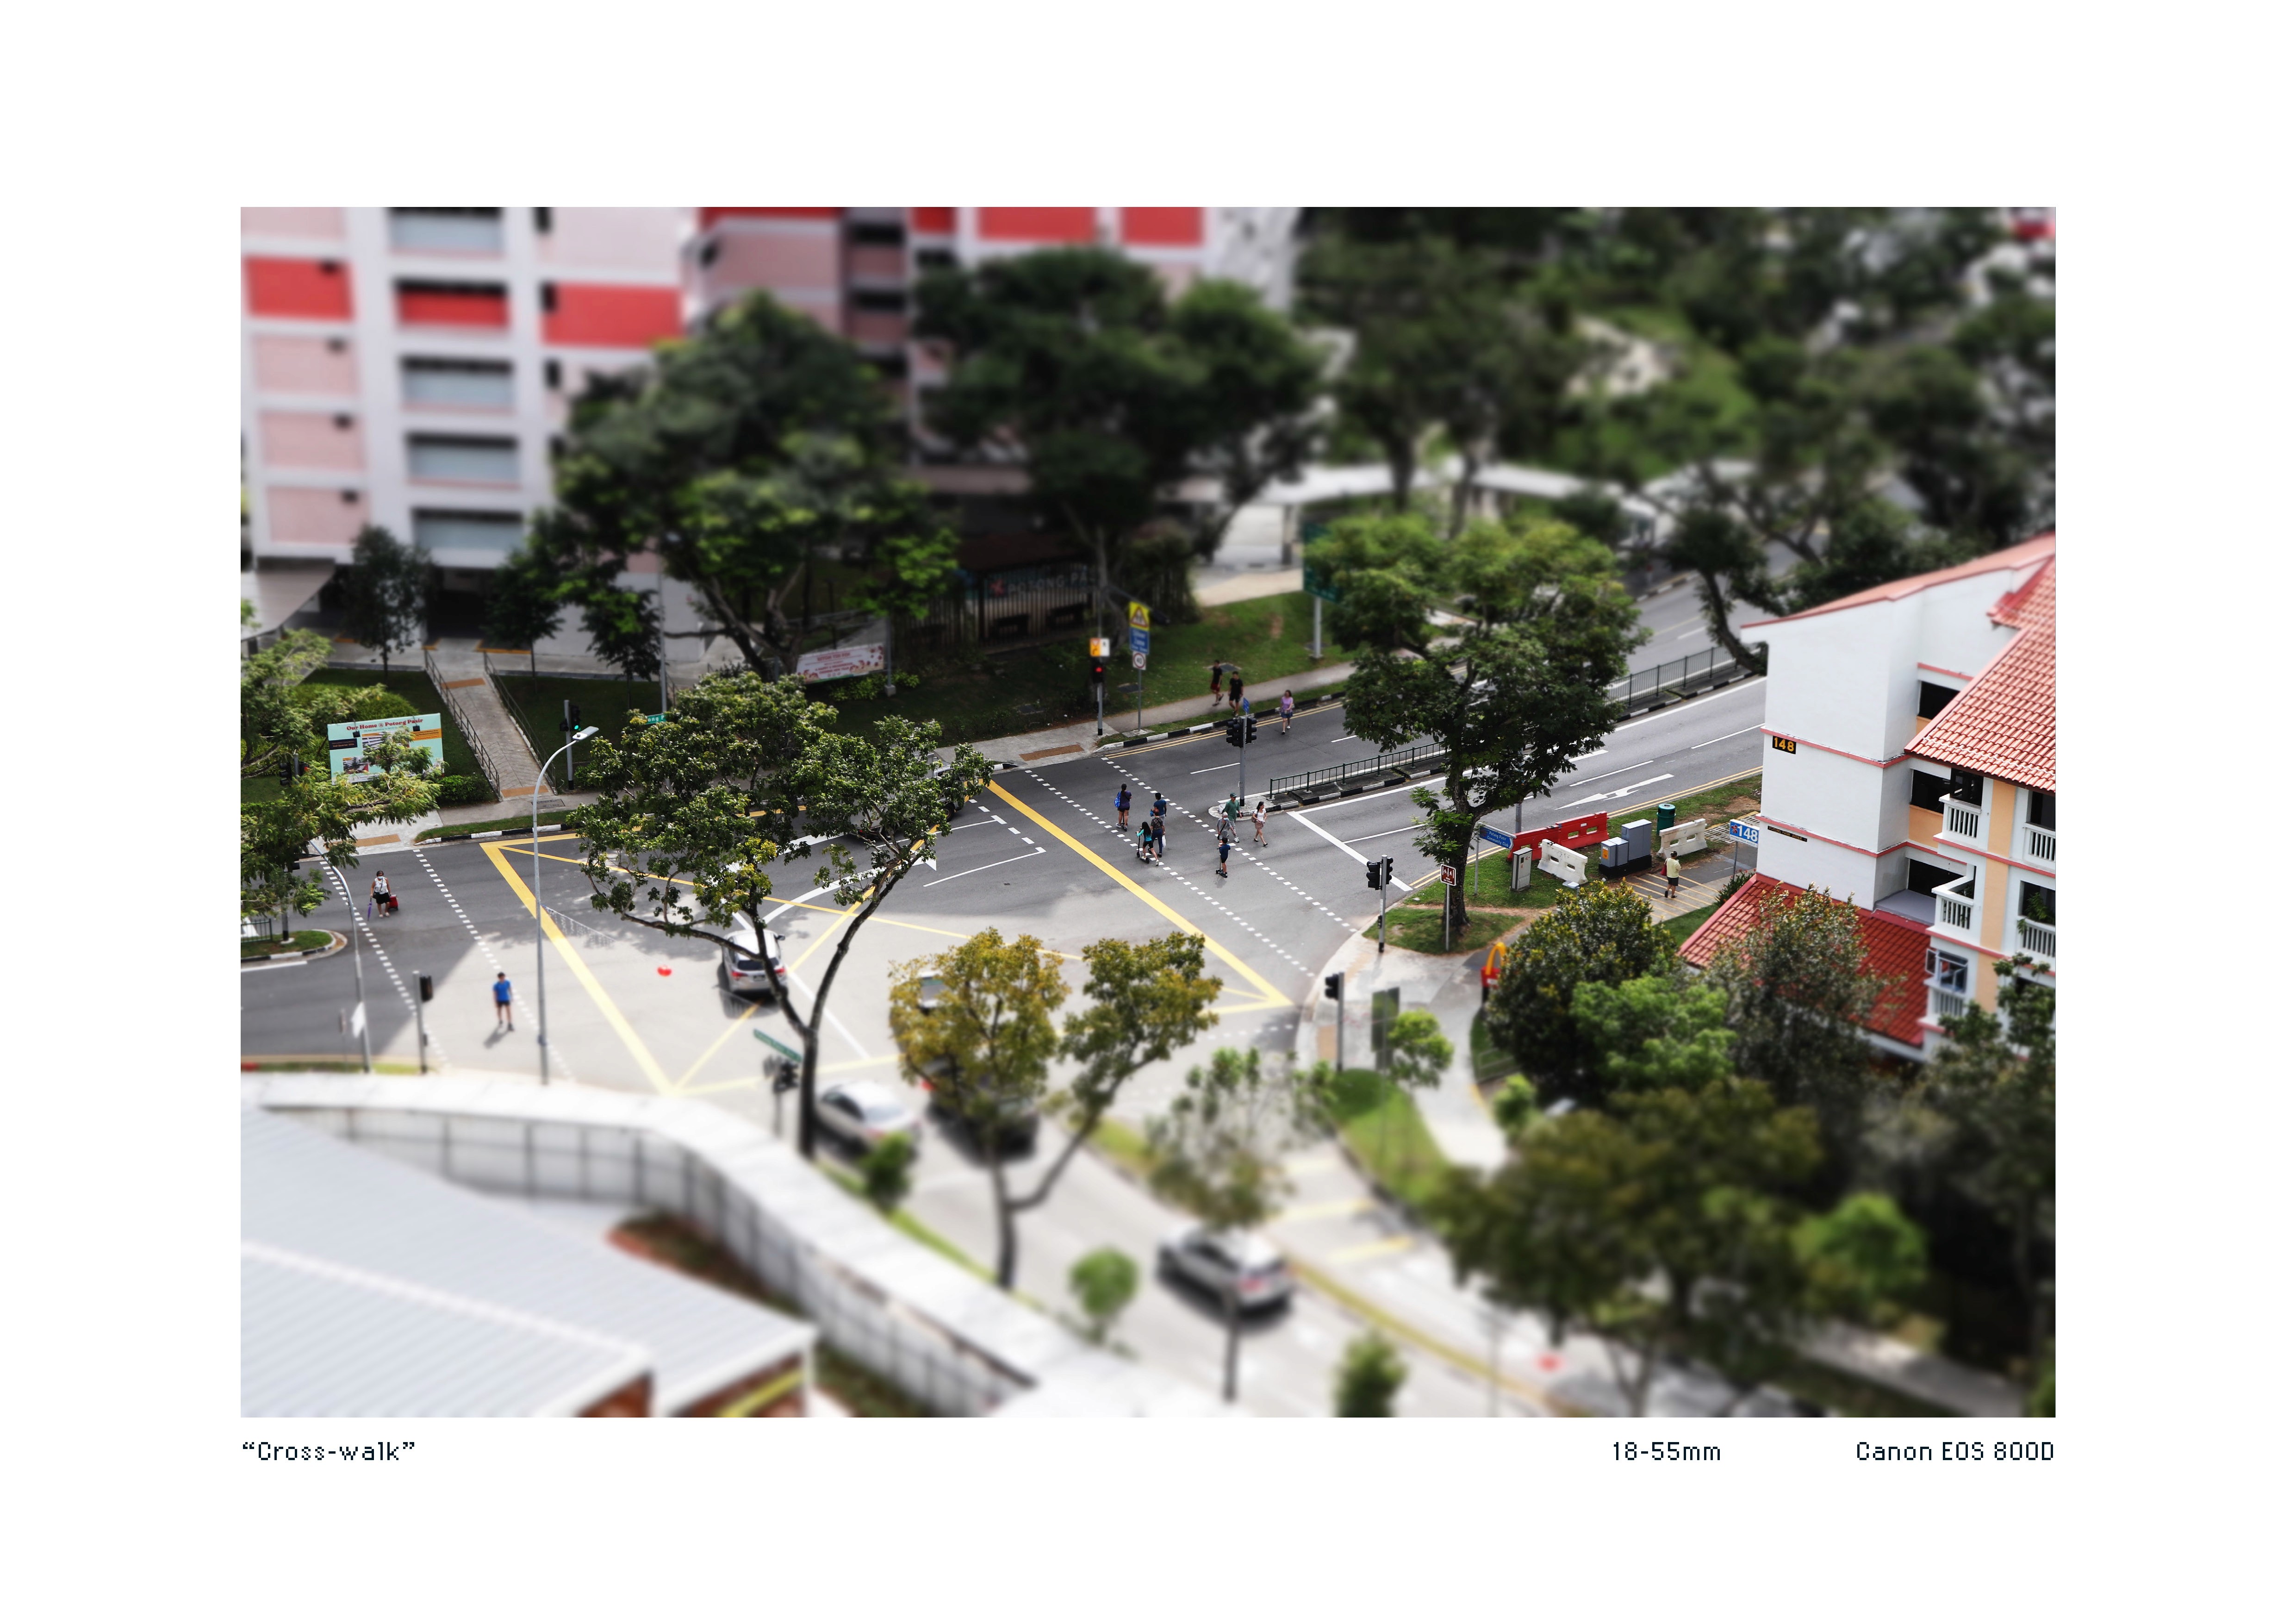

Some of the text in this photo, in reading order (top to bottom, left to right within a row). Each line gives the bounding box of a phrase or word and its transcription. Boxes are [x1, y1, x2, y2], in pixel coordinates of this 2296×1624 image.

[1774, 737, 1794, 752] 148
[1487, 836, 1502, 845] Community
[1737, 825, 1758, 842] 148
